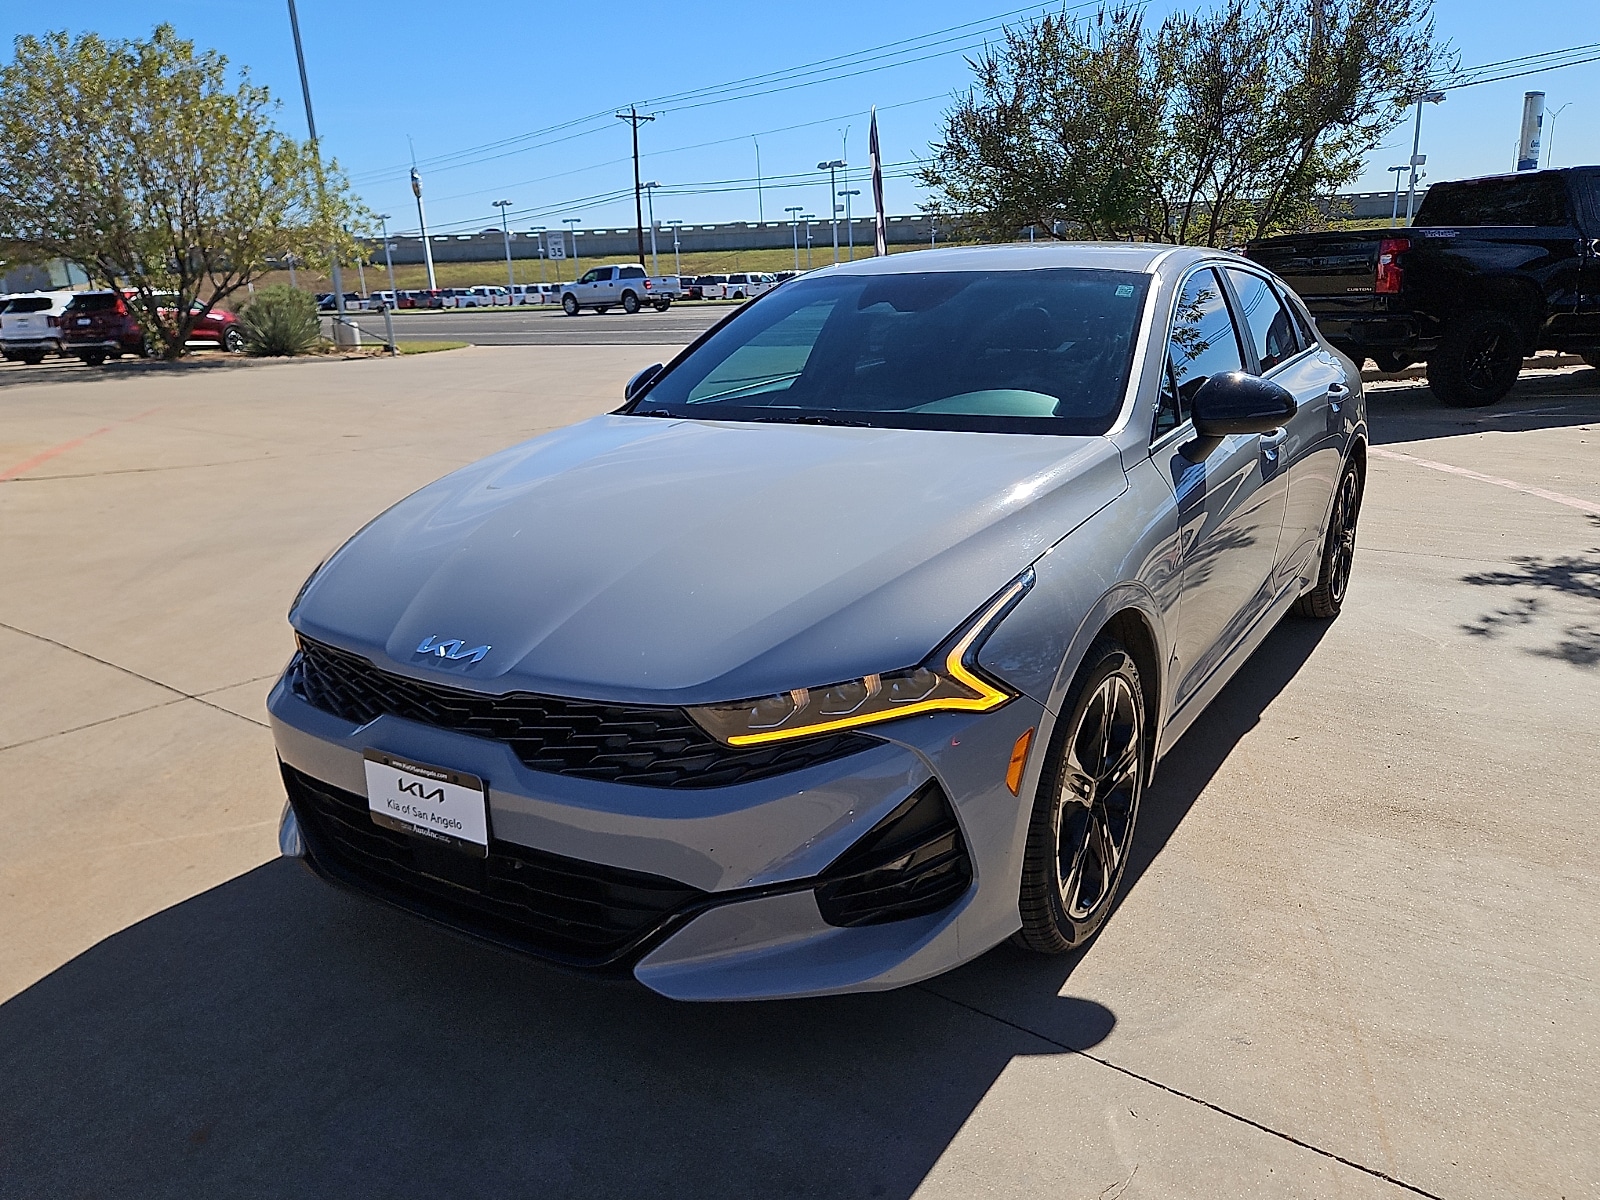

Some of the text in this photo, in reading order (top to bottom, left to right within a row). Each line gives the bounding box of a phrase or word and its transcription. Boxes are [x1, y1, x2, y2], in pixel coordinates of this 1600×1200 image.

[551, 248, 563, 257] 35
[416, 634, 492, 664] KIA
[398, 777, 445, 804] KIA
[387, 799, 463, 830] Kia of San Angelo
